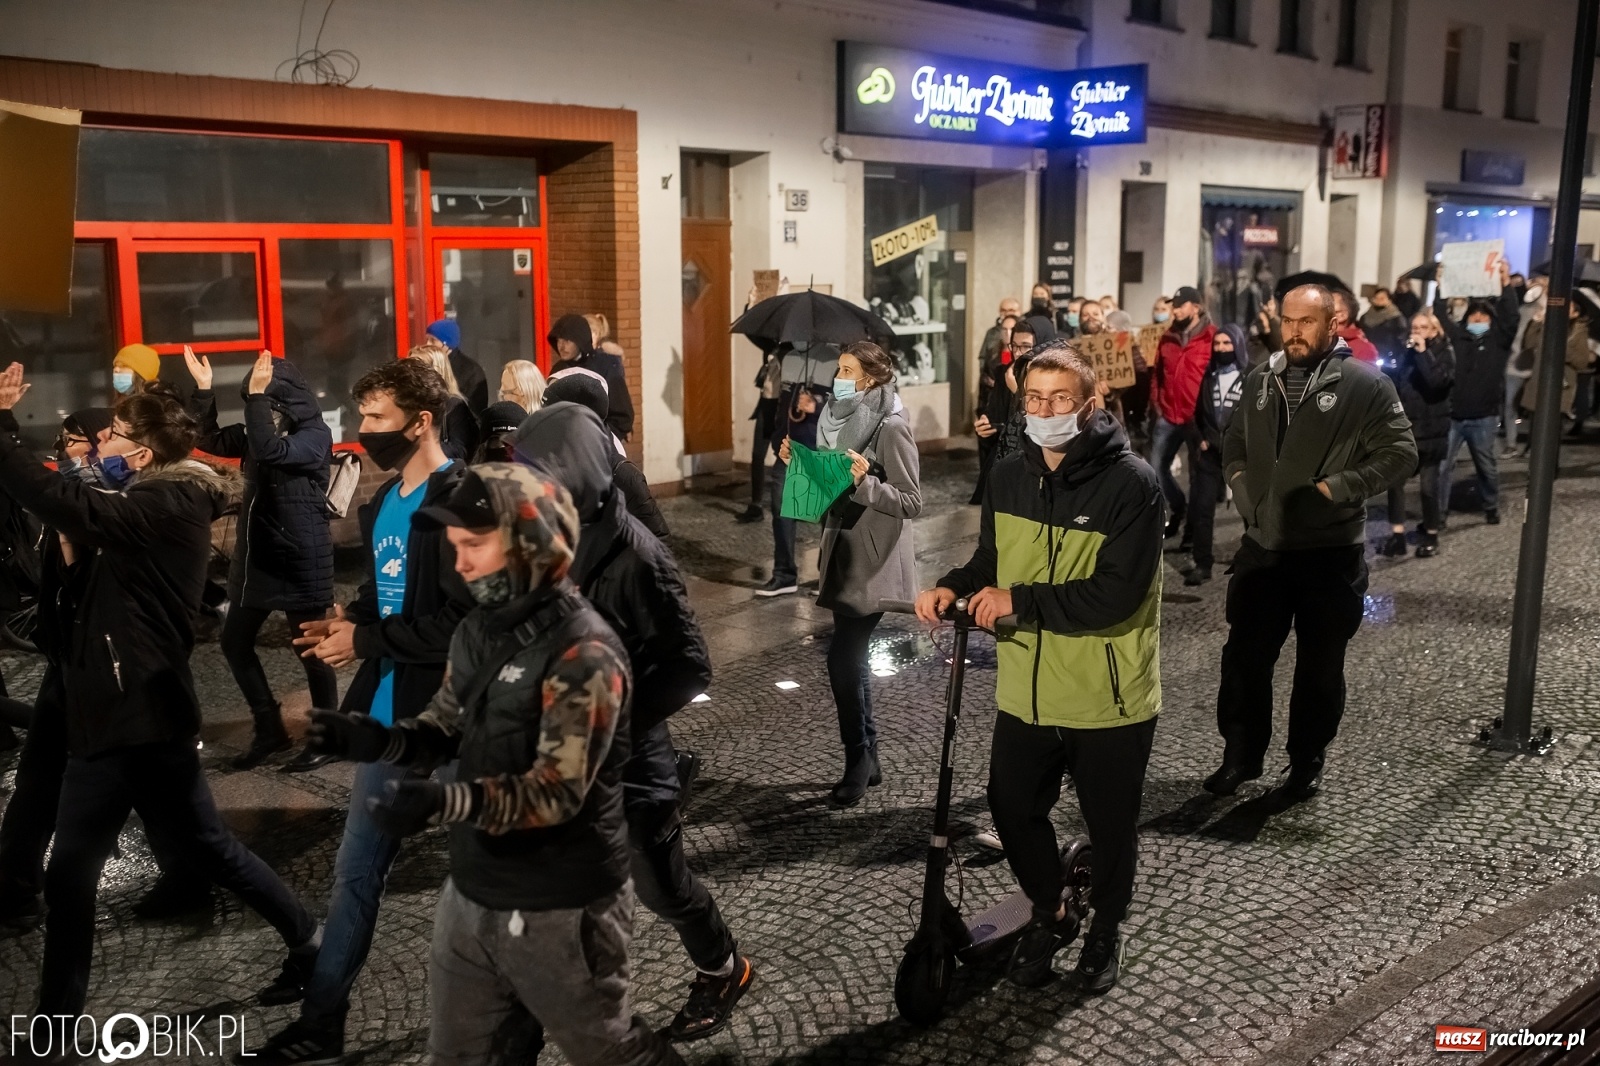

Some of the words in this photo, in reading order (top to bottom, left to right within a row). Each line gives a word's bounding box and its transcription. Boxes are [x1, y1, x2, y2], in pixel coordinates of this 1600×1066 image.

[911, 65, 986, 124] Jubiler
[1070, 80, 1131, 113] Jubiler
[791, 193, 807, 206] 36
[874, 232, 909, 261] ZŁOTO
[1095, 351, 1128, 365] REM
[381, 558, 403, 578] 4F
